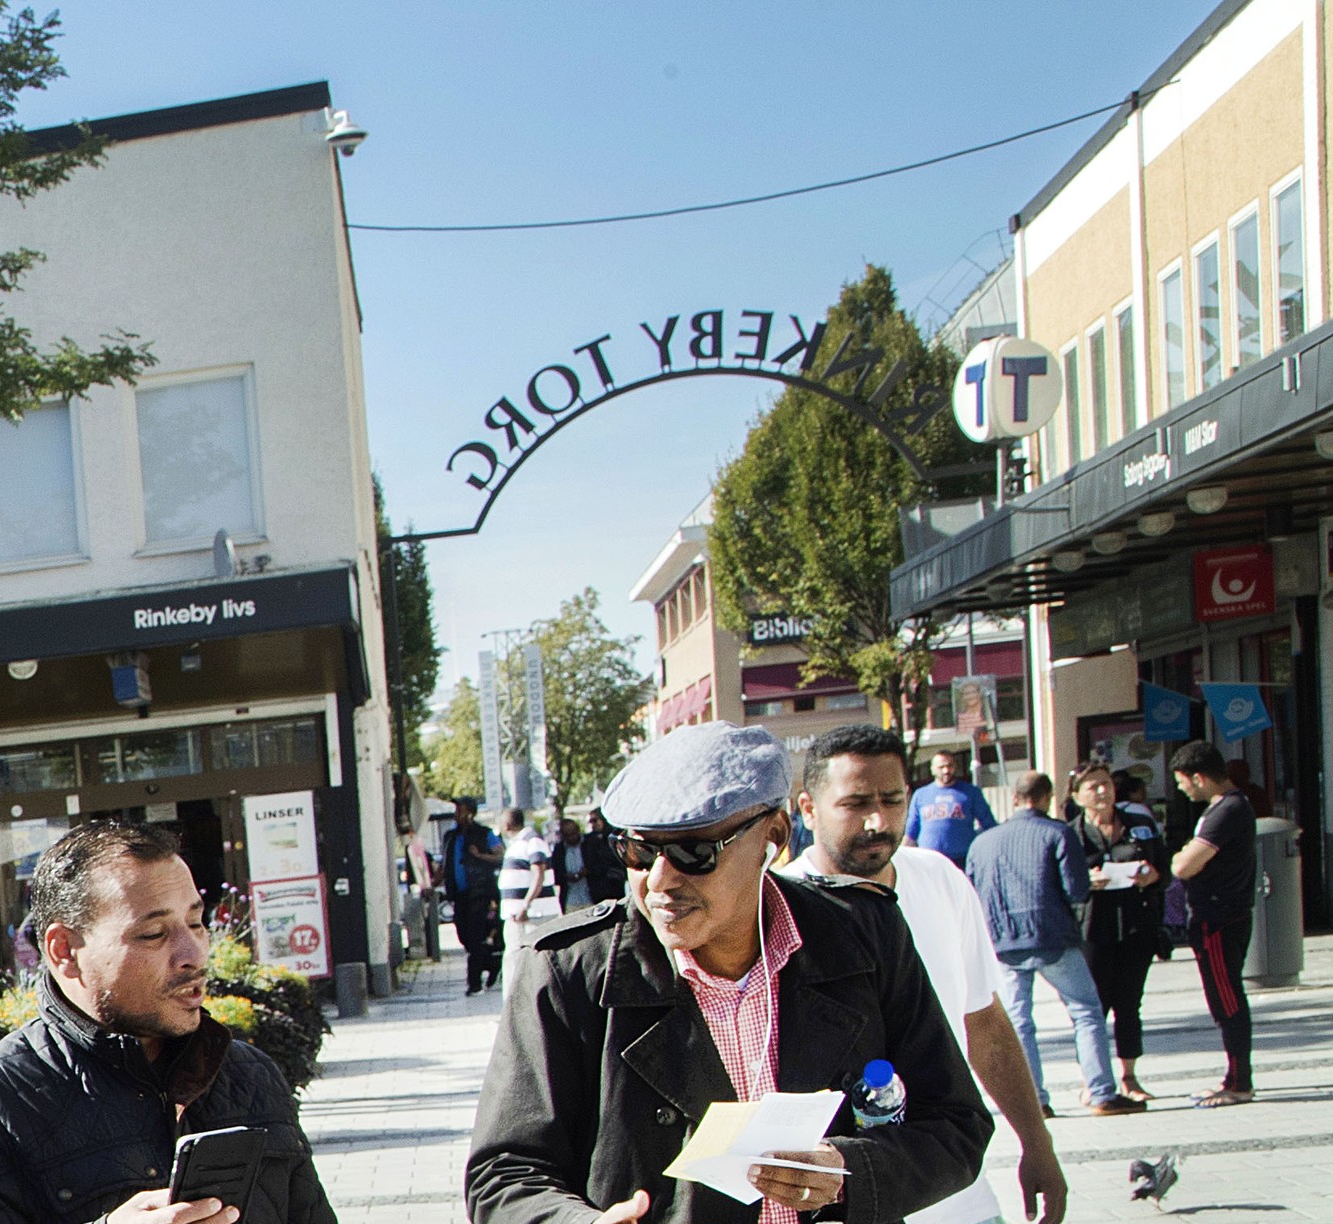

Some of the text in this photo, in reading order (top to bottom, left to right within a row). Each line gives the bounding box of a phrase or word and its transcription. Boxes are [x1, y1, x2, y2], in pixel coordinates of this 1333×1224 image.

[965, 360, 986, 427] T
[1002, 355, 1047, 422] T
[134, 599, 256, 629] Rinkeby livs
[753, 613, 820, 641] Biblio
[255, 807, 304, 821] LINSER
